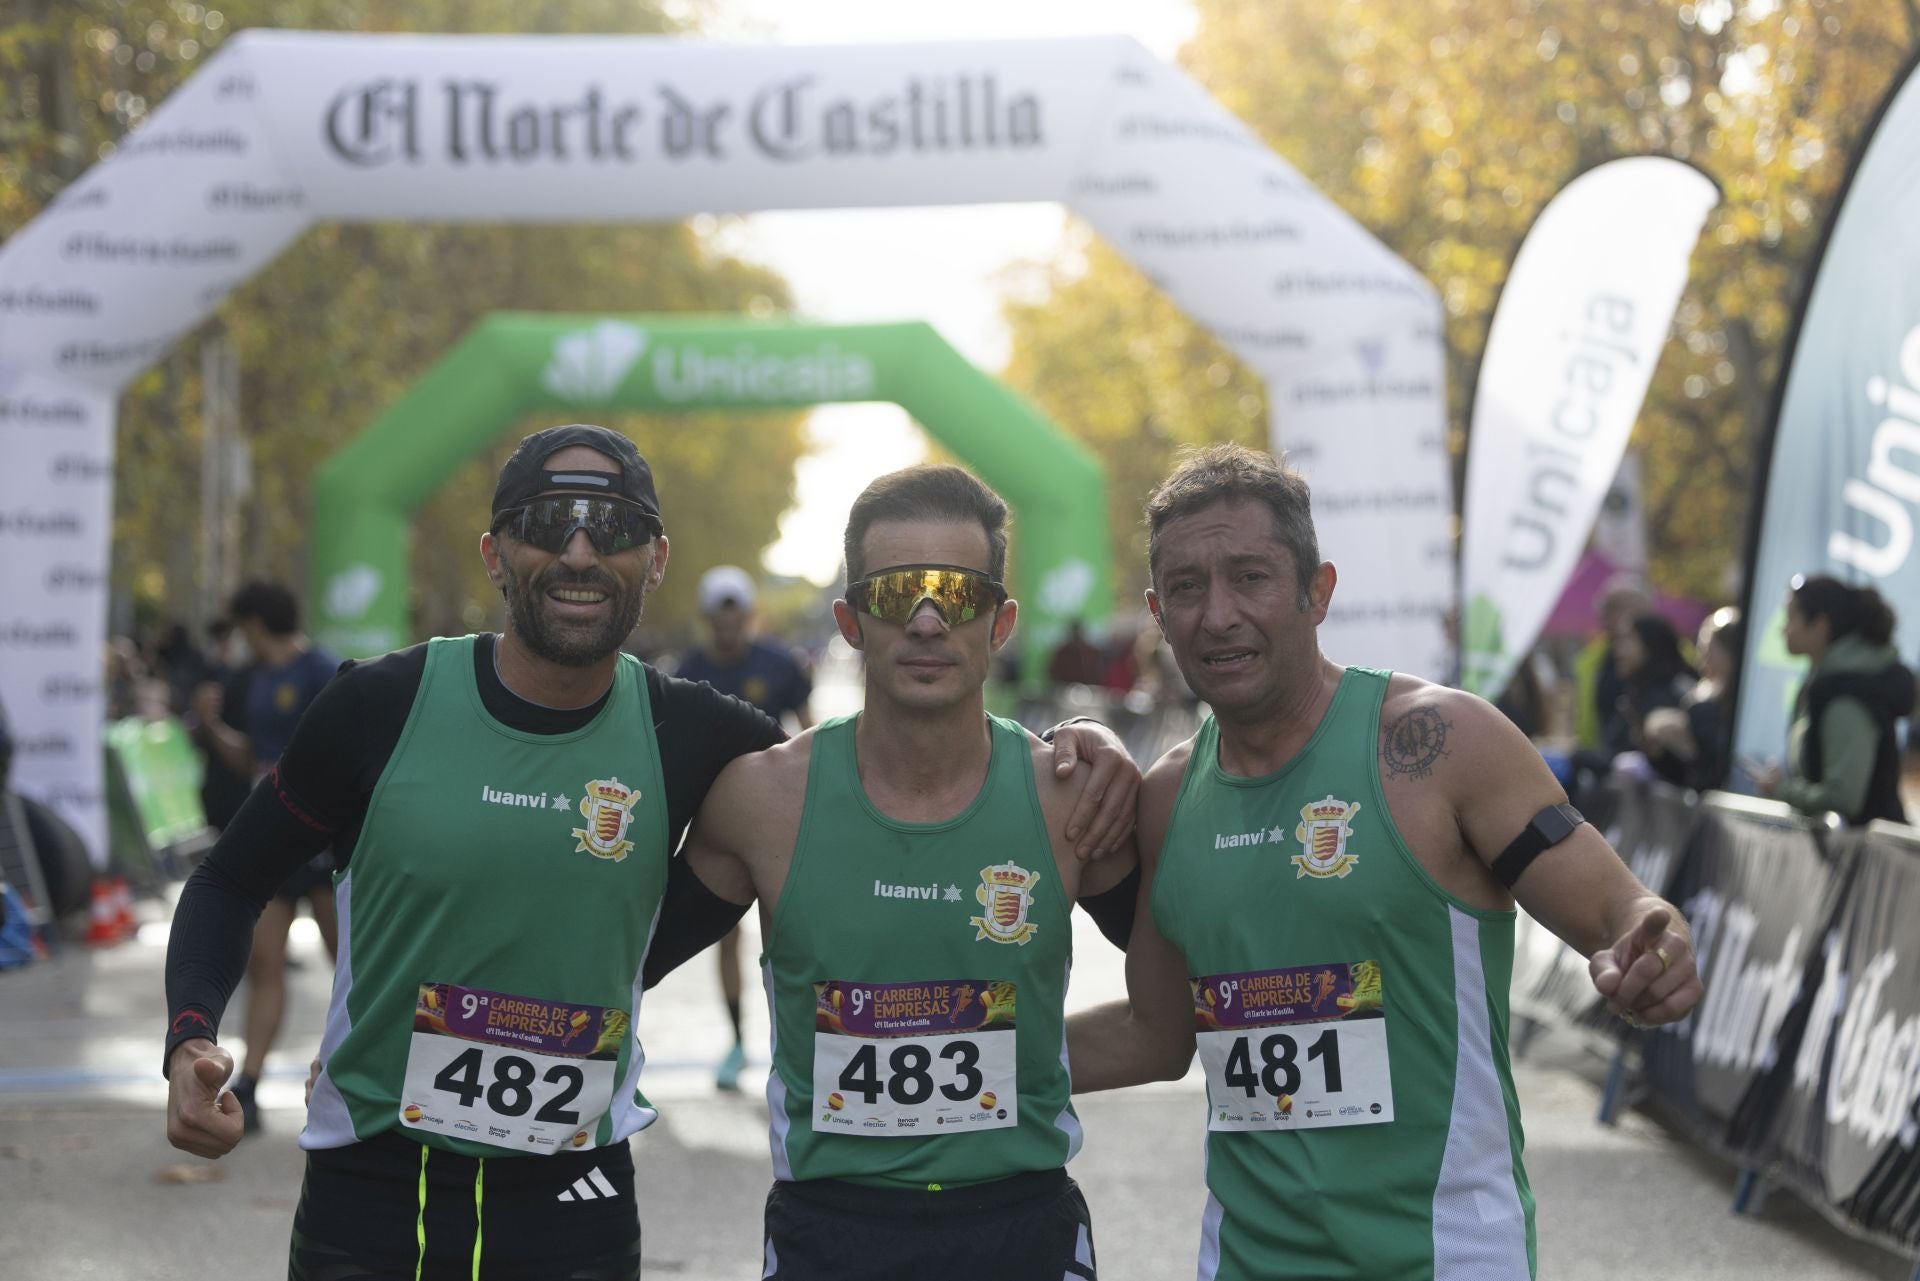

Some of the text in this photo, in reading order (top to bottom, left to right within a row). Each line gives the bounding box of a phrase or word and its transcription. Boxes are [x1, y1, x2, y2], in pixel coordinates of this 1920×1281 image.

[322, 72, 1045, 169] El Norte de Castilla
[1502, 294, 1638, 571] Unicaja
[482, 786, 546, 808] luanvi
[1215, 828, 1264, 849] luanvi
[874, 880, 938, 900] luanvi
[1240, 974, 1292, 992] CARRERA
[1296, 973, 1311, 987] DE
[873, 987, 931, 1002] CARRERA
[934, 986, 950, 999] DE
[1242, 987, 1312, 1009] EMPRESAS
[491, 997, 548, 1019] CARRERA
[552, 1007, 569, 1021] DE
[874, 1000, 949, 1019] EMPRESAS
[488, 1011, 565, 1037] EMPRESAS
[906, 1019, 930, 1027] Castilla
[839, 1040, 983, 1104] 483
[1224, 1029, 1342, 1098] 481
[433, 1047, 584, 1125] 482
[454, 1123, 478, 1132] elecnor
